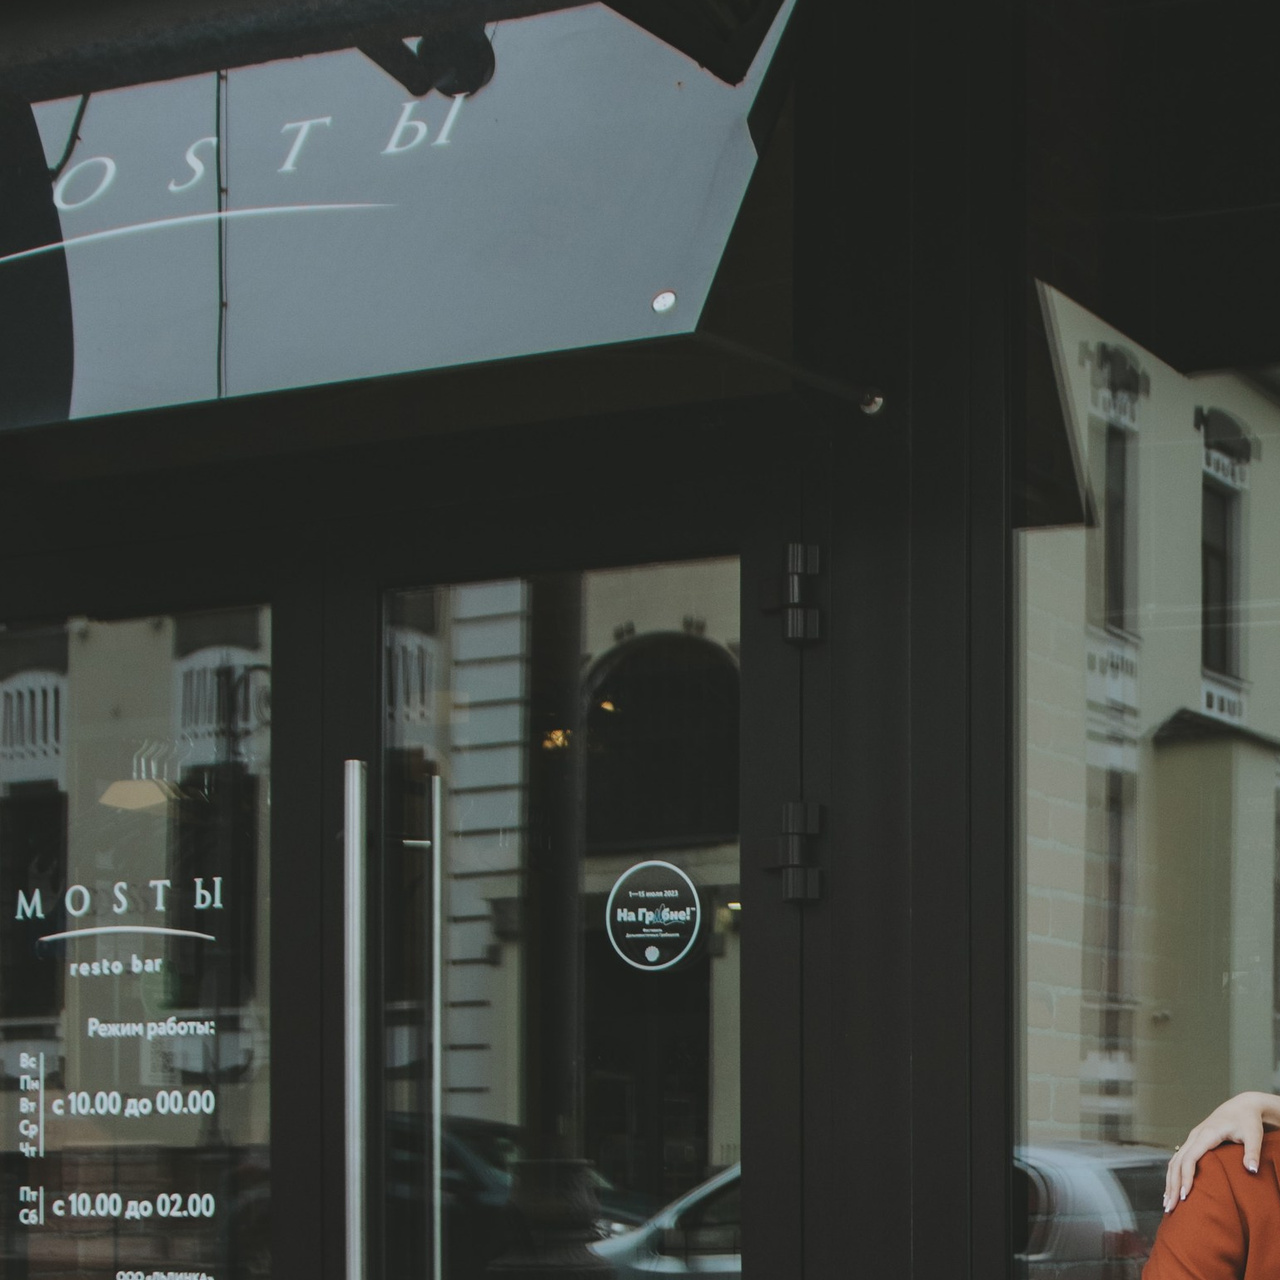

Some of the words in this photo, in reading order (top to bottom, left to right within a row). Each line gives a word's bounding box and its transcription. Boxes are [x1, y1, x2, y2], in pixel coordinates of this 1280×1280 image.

[616, 908, 636, 922] На
[69, 957, 123, 977] resto
[131, 954, 163, 974] bar
[87, 1017, 143, 1038] Режим
[146, 1016, 216, 1041] работы:
[19, 1053, 37, 1069] Вс
[19, 1075, 39, 1091] Пн
[19, 1098, 37, 1114] Вт
[51, 1098, 65, 1116] с
[67, 1091, 122, 1116] 10.00
[124, 1097, 152, 1118] до
[155, 1090, 216, 1115] 00.00
[19, 1119, 39, 1139] Ср
[19, 1142, 38, 1158] Чт
[19, 1186, 38, 1203] Пт
[51, 1200, 65, 1217] с
[67, 1193, 122, 1217] 10.00
[124, 1199, 153, 1220] до
[156, 1193, 216, 1218] 02.00
[19, 1208, 39, 1226] Сб
